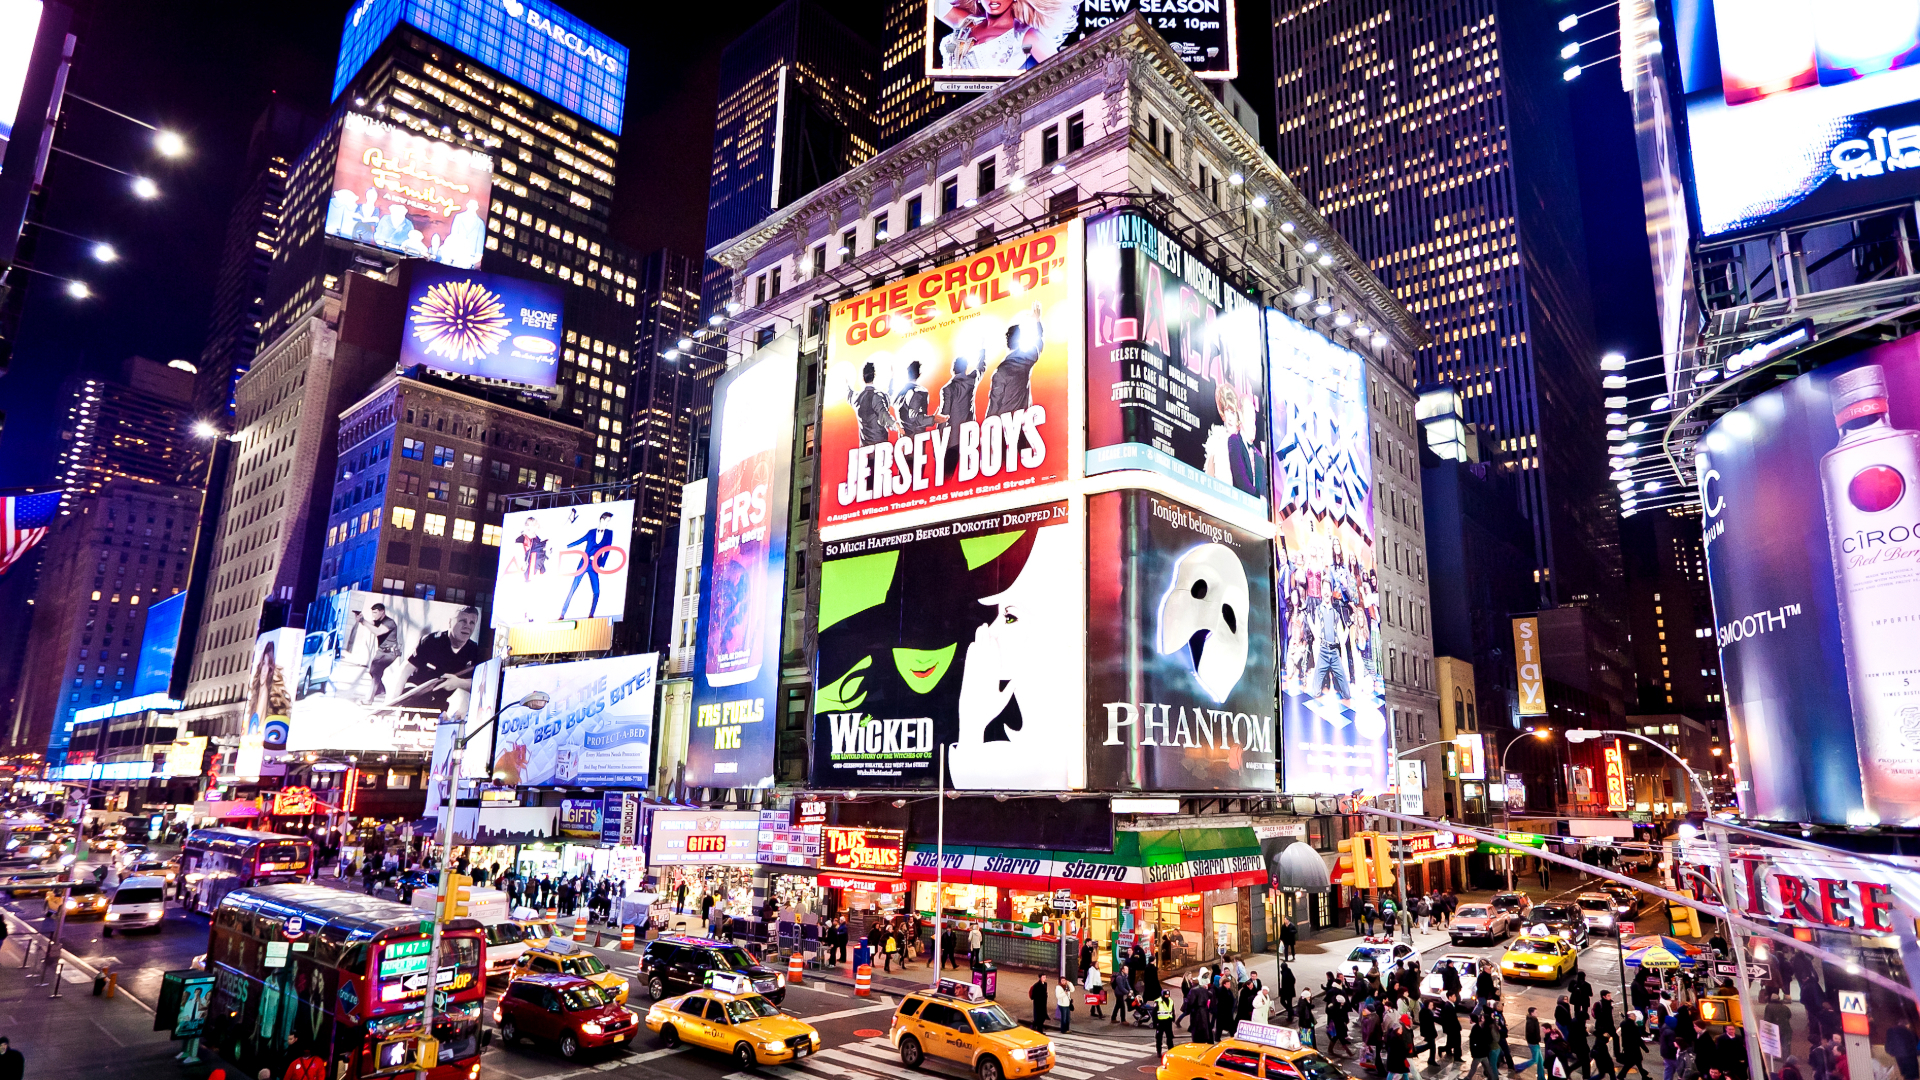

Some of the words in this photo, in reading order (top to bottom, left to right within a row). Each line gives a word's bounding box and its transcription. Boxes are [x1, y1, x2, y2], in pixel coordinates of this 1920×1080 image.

[1084, 0, 1130, 12] NEW
[1139, 0, 1220, 13] SEASON
[1159, 17, 1177, 29] 24
[1184, 17, 1220, 31] 10pm
[526, 9, 618, 73] BARCLAYS
[946, 83, 968, 91] city
[347, 110, 397, 133] NATHAN
[370, 168, 462, 218] Family
[1118, 241, 1140, 250] TONY
[918, 234, 1057, 299] CROWD
[1096, 214, 1158, 253] WINNER!
[1157, 230, 1182, 278] BEST
[1184, 251, 1223, 309] MUSICAL
[520, 308, 558, 323] BUONE
[521, 316, 555, 331] FESTE.
[846, 299, 937, 346] GOES
[919, 326, 937, 336] New
[938, 319, 956, 330] York
[958, 311, 981, 323] Times
[1110, 347, 1140, 363] KELSEY
[1130, 364, 1141, 379] LA
[1143, 366, 1157, 386] CAGE
[1111, 387, 1133, 402] JERRY
[837, 425, 951, 507] JERSEY
[958, 404, 1047, 483] BOYS
[862, 504, 889, 516] Wilson
[890, 498, 928, 511] Theatre,
[929, 492, 949, 503] 245
[950, 487, 974, 499] West
[975, 481, 1001, 494] 52nd
[1002, 476, 1036, 489] Street
[719, 483, 769, 539] FRS
[1151, 498, 1188, 530] Tonight
[1188, 512, 1223, 543] belongs
[1846, 549, 1882, 570] Red
[1903, 677, 1910, 688] 5
[500, 711, 541, 735] DON'T
[577, 674, 608, 703] THE
[533, 718, 563, 745] BED
[565, 695, 606, 730] BUGS
[609, 665, 652, 707] BITE!
[697, 703, 721, 727] FRS
[721, 698, 764, 725] FUELS
[714, 725, 742, 750] NYC
[1102, 702, 1273, 753] PHANTOM
[1604, 749, 1623, 807] PARK
[568, 808, 598, 824] GIFTS
[689, 837, 725, 851] GIFTS
[850, 847, 898, 869] STEAKS
[984, 853, 1041, 875] sbarro
[1193, 856, 1225, 877] sbarro
[1232, 854, 1261, 873] sbarro
[1062, 858, 1128, 882] sbarro
[1149, 861, 1185, 883] sbarro
[396, 944, 405, 956] W
[406, 942, 420, 954] 47
[1722, 964, 1737, 973] ONE
[411, 976, 428, 986] ONE
[1239, 1022, 1263, 1034] PRIVATE
[1263, 1027, 1278, 1036] EYES
[956, 1038, 972, 1050] TAXI
